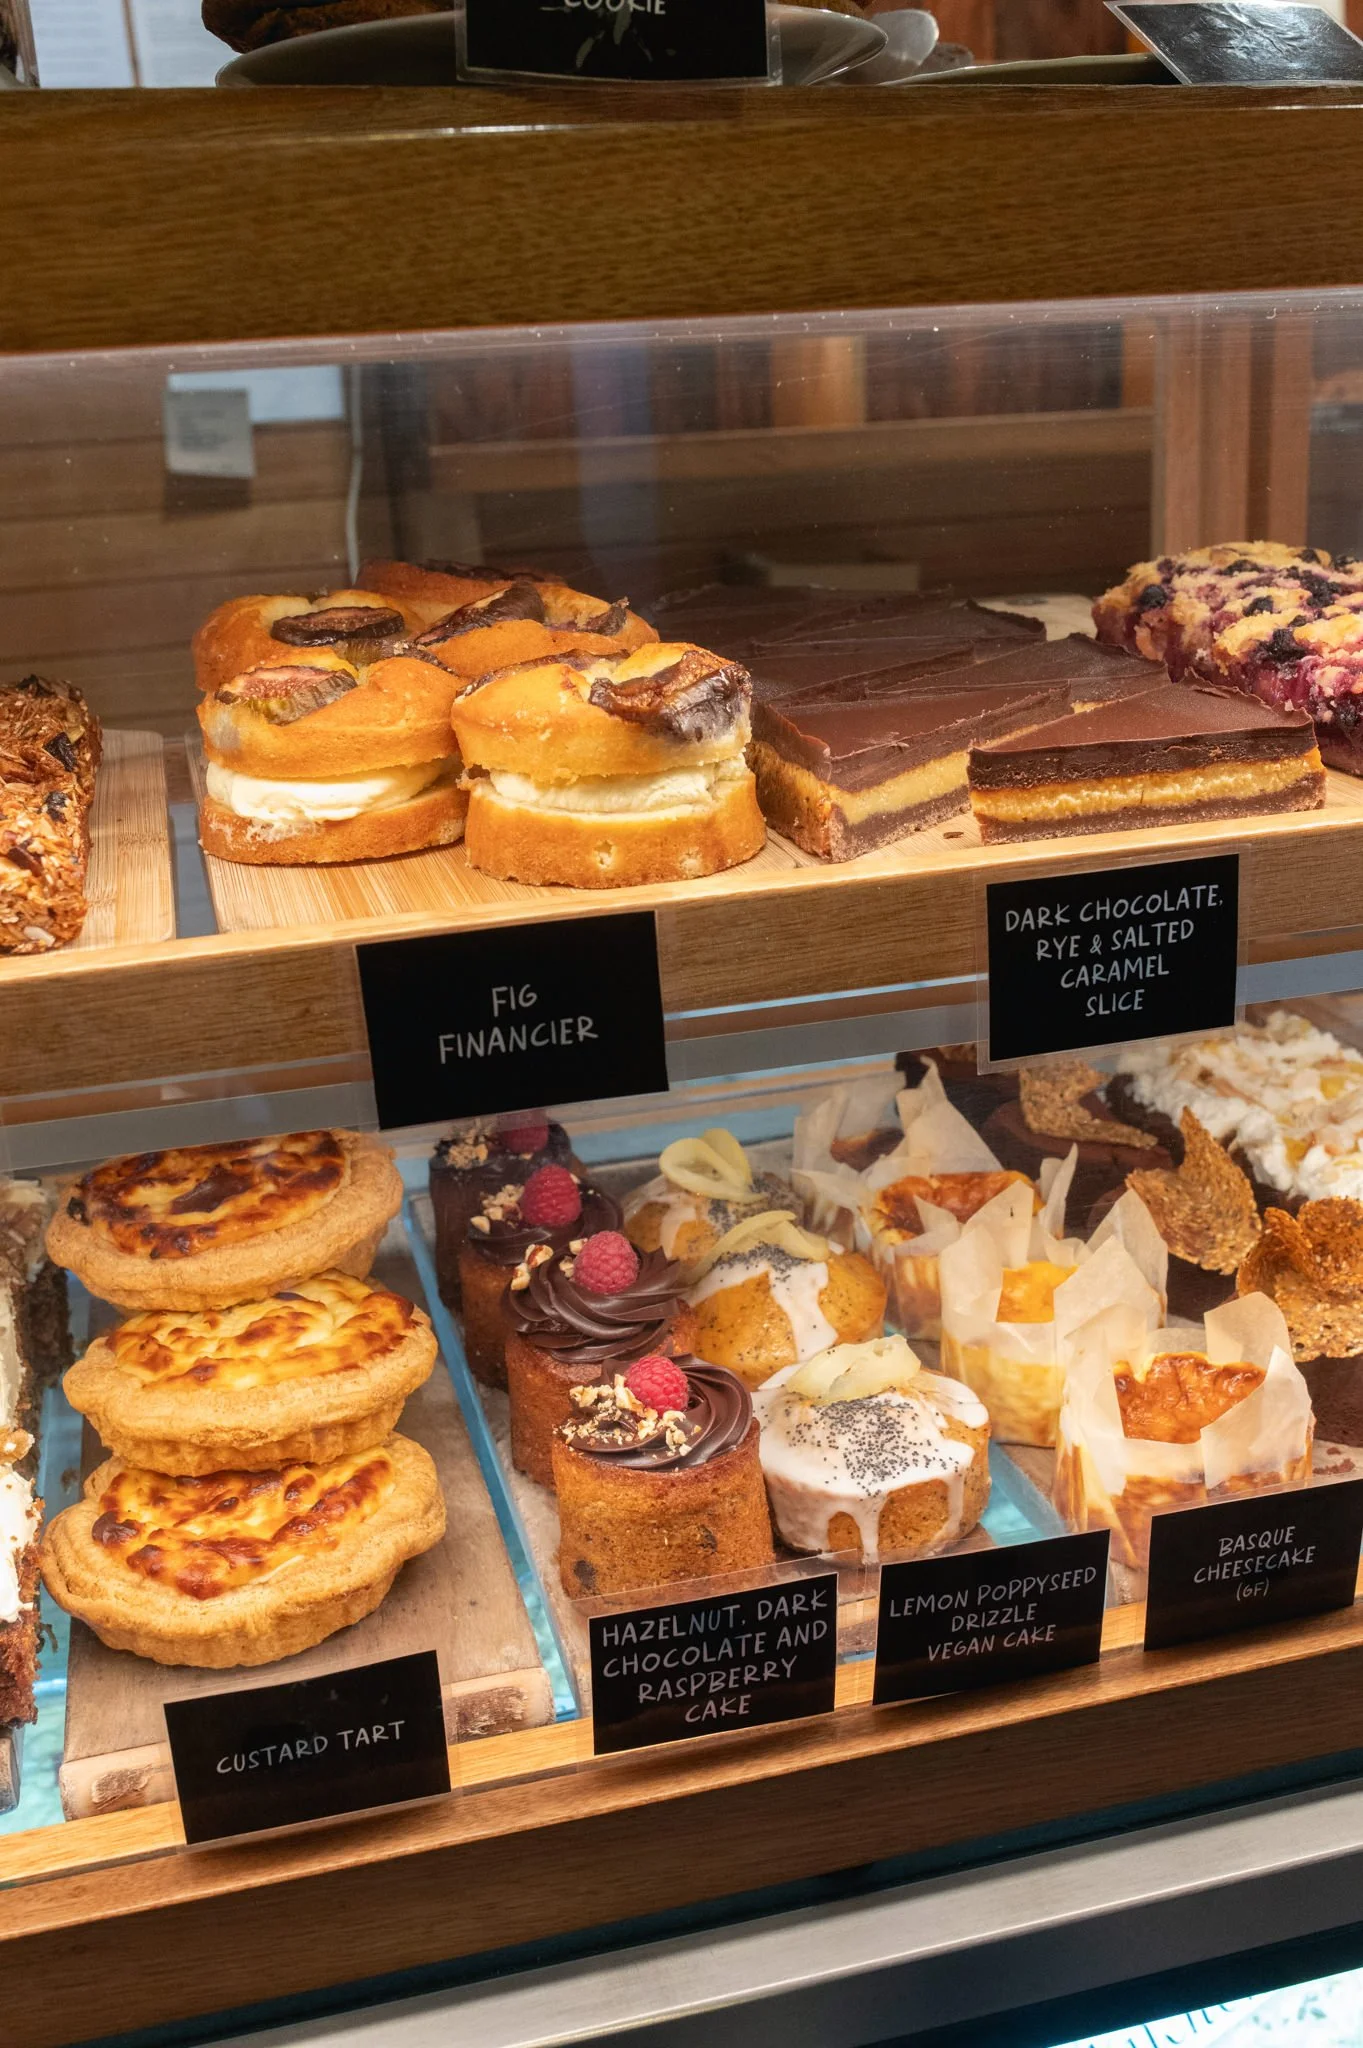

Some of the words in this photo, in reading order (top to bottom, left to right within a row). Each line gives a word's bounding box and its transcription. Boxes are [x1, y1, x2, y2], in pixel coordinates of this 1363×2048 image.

[1005, 903, 1071, 932] DARK
[1079, 884, 1223, 922] CHOCOLATE,
[1036, 935, 1081, 961] RYE
[1089, 934, 1102, 955] &
[1111, 919, 1194, 951] SALTED
[1060, 953, 1170, 989] CARAMEL
[492, 984, 537, 1017] FIG
[1085, 988, 1145, 1017] SLICE
[439, 1016, 598, 1064] FINANCIER
[1218, 1525, 1296, 1557] BASQUE
[1193, 1545, 1316, 1584] CHEESECAKE
[757, 1589, 827, 1621] DARK
[890, 1590, 969, 1617] LEMON
[977, 1566, 1097, 1605] POPPYSEED
[1235, 1577, 1270, 1601] (GF)
[951, 1603, 1037, 1632] DRIZZLE
[603, 1631, 766, 1679] CHOCOLATE
[776, 1620, 828, 1649] AND
[928, 1635, 995, 1662] VEGAN
[1003, 1624, 1056, 1648] CAKE
[638, 1654, 798, 1704] RASPBERRY
[685, 1694, 751, 1723] CAKE
[216, 1736, 328, 1774] CUSTARD
[337, 1720, 405, 1750] TART
